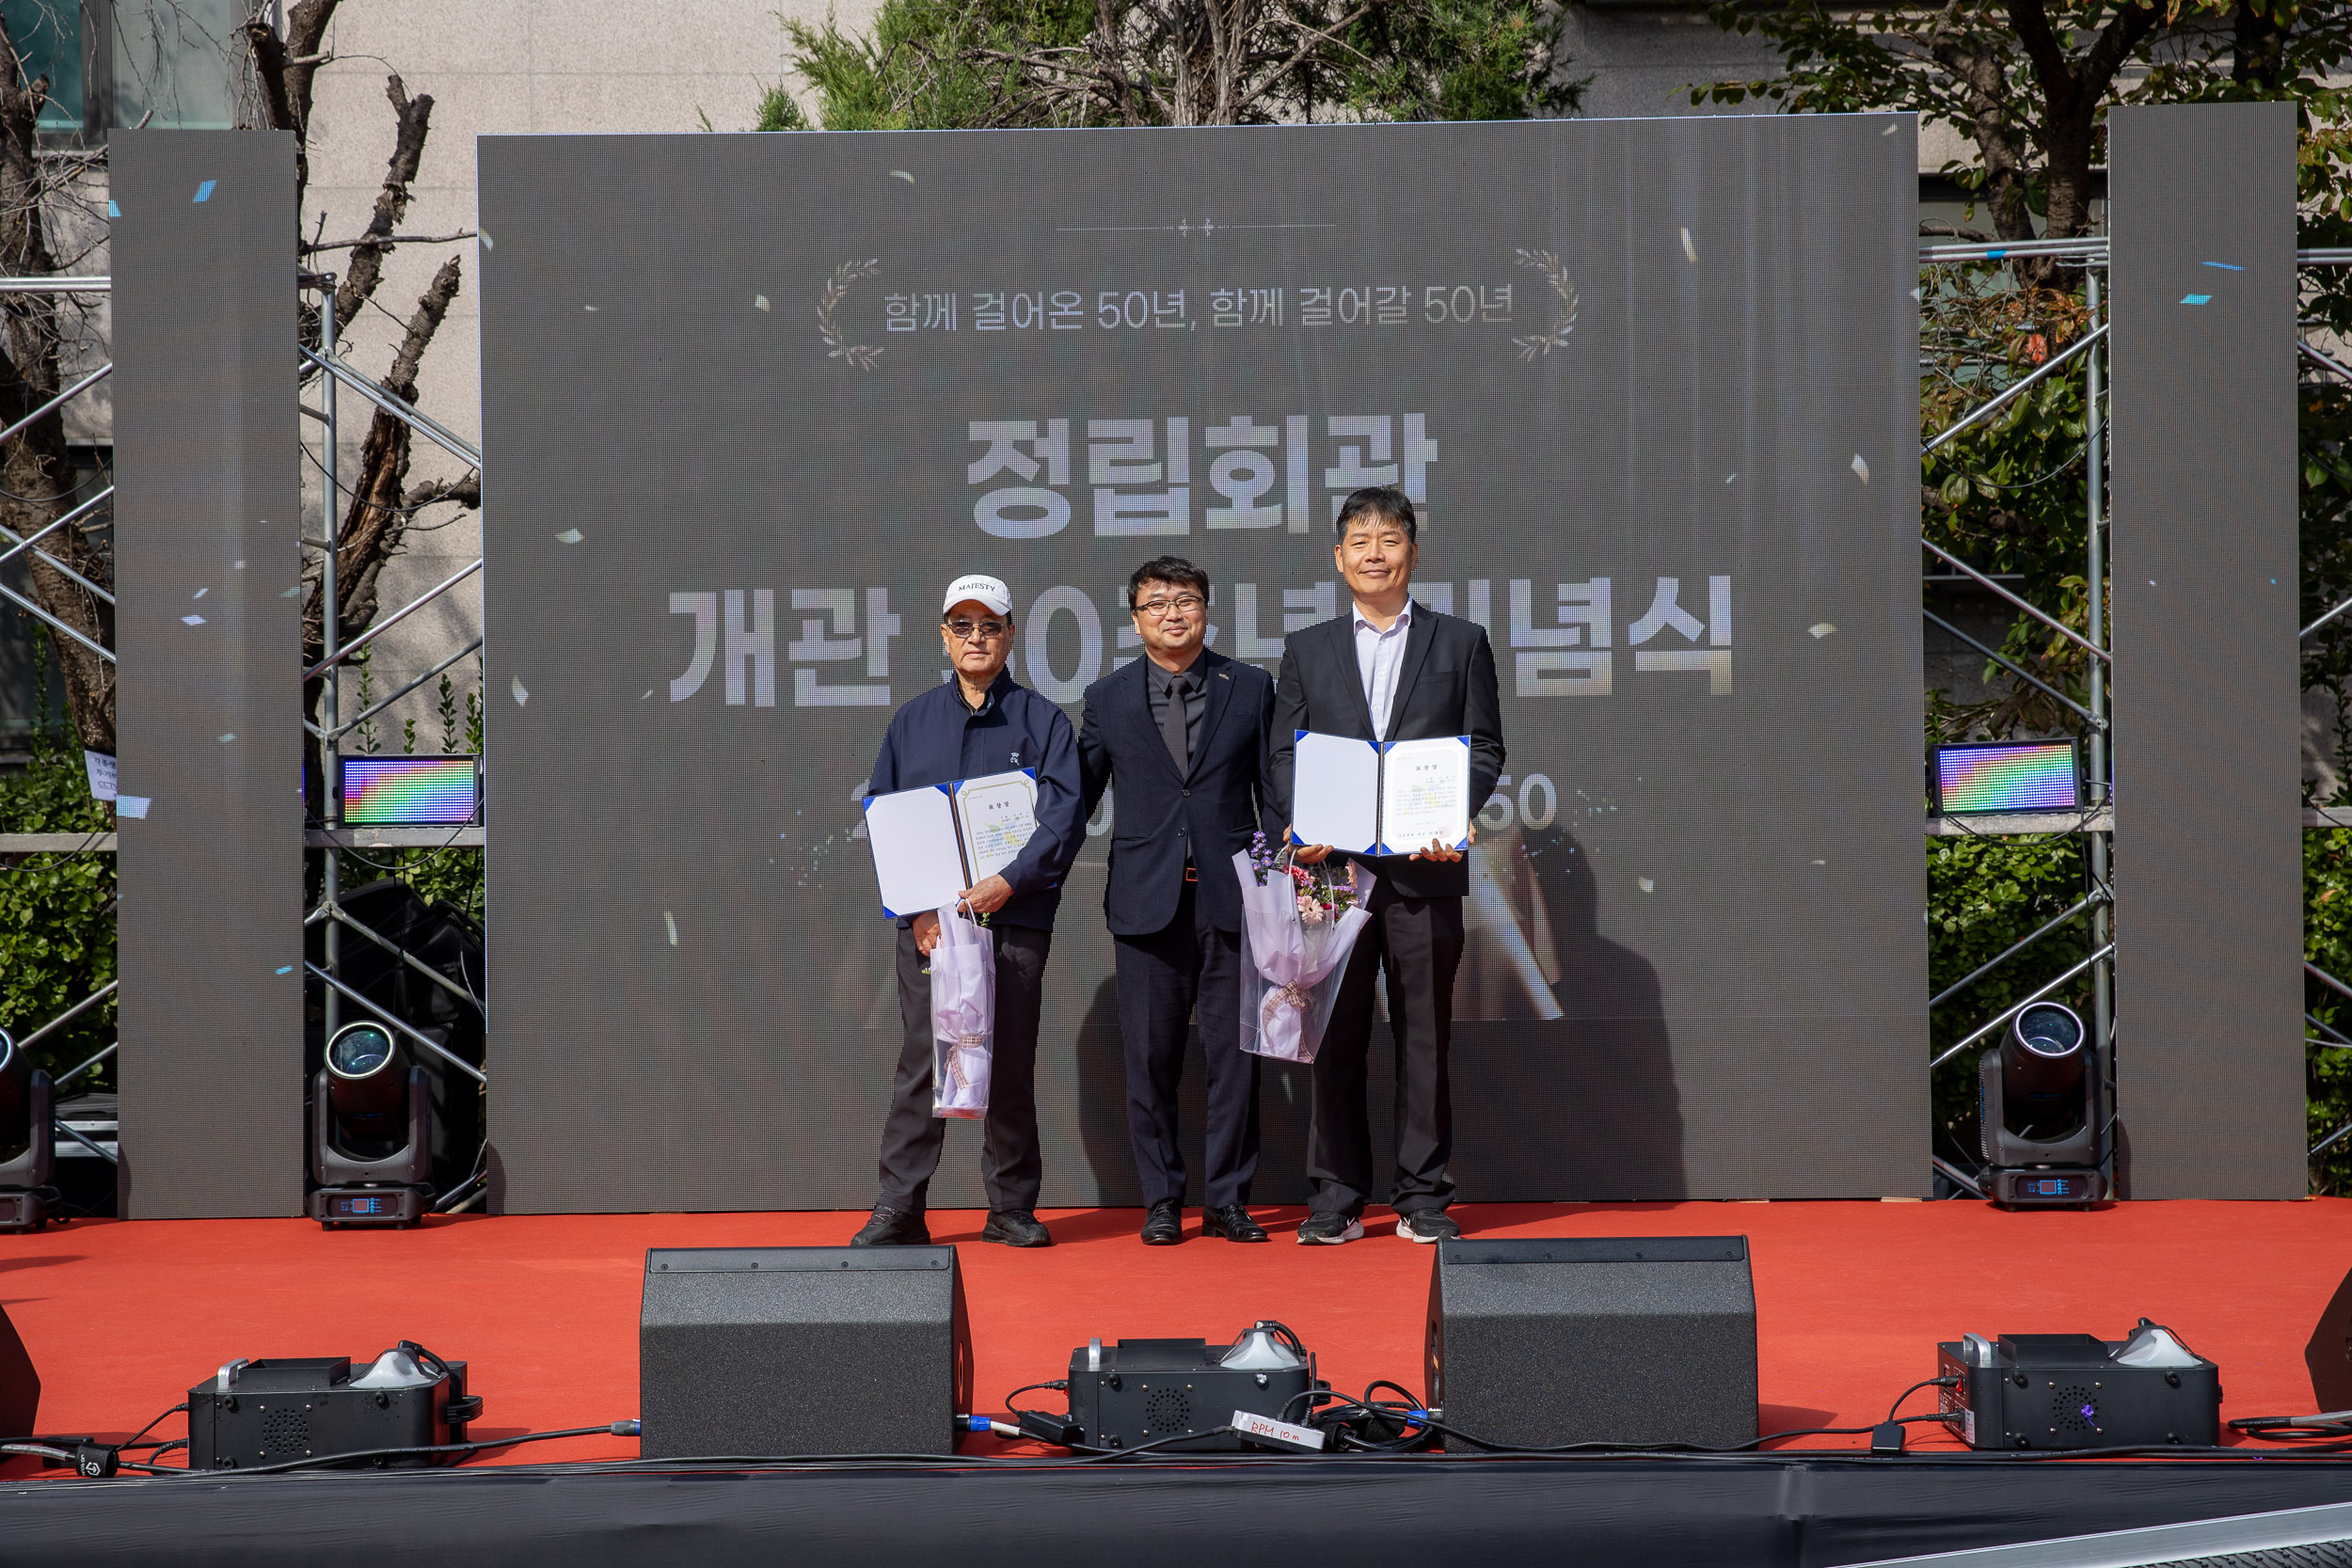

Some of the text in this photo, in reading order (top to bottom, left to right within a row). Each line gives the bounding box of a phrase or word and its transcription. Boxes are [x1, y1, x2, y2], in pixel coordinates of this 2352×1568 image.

[884, 283, 1513, 332] 함께 걸어온 50년, 함께 걸어갈 50년
[967, 412, 1438, 539] 정립회관
[958, 582, 995, 593] MAJESTY
[669, 587, 901, 707] 개관
[1250, 1421, 1275, 1437] RPM
[1279, 1430, 1290, 1439] 10
